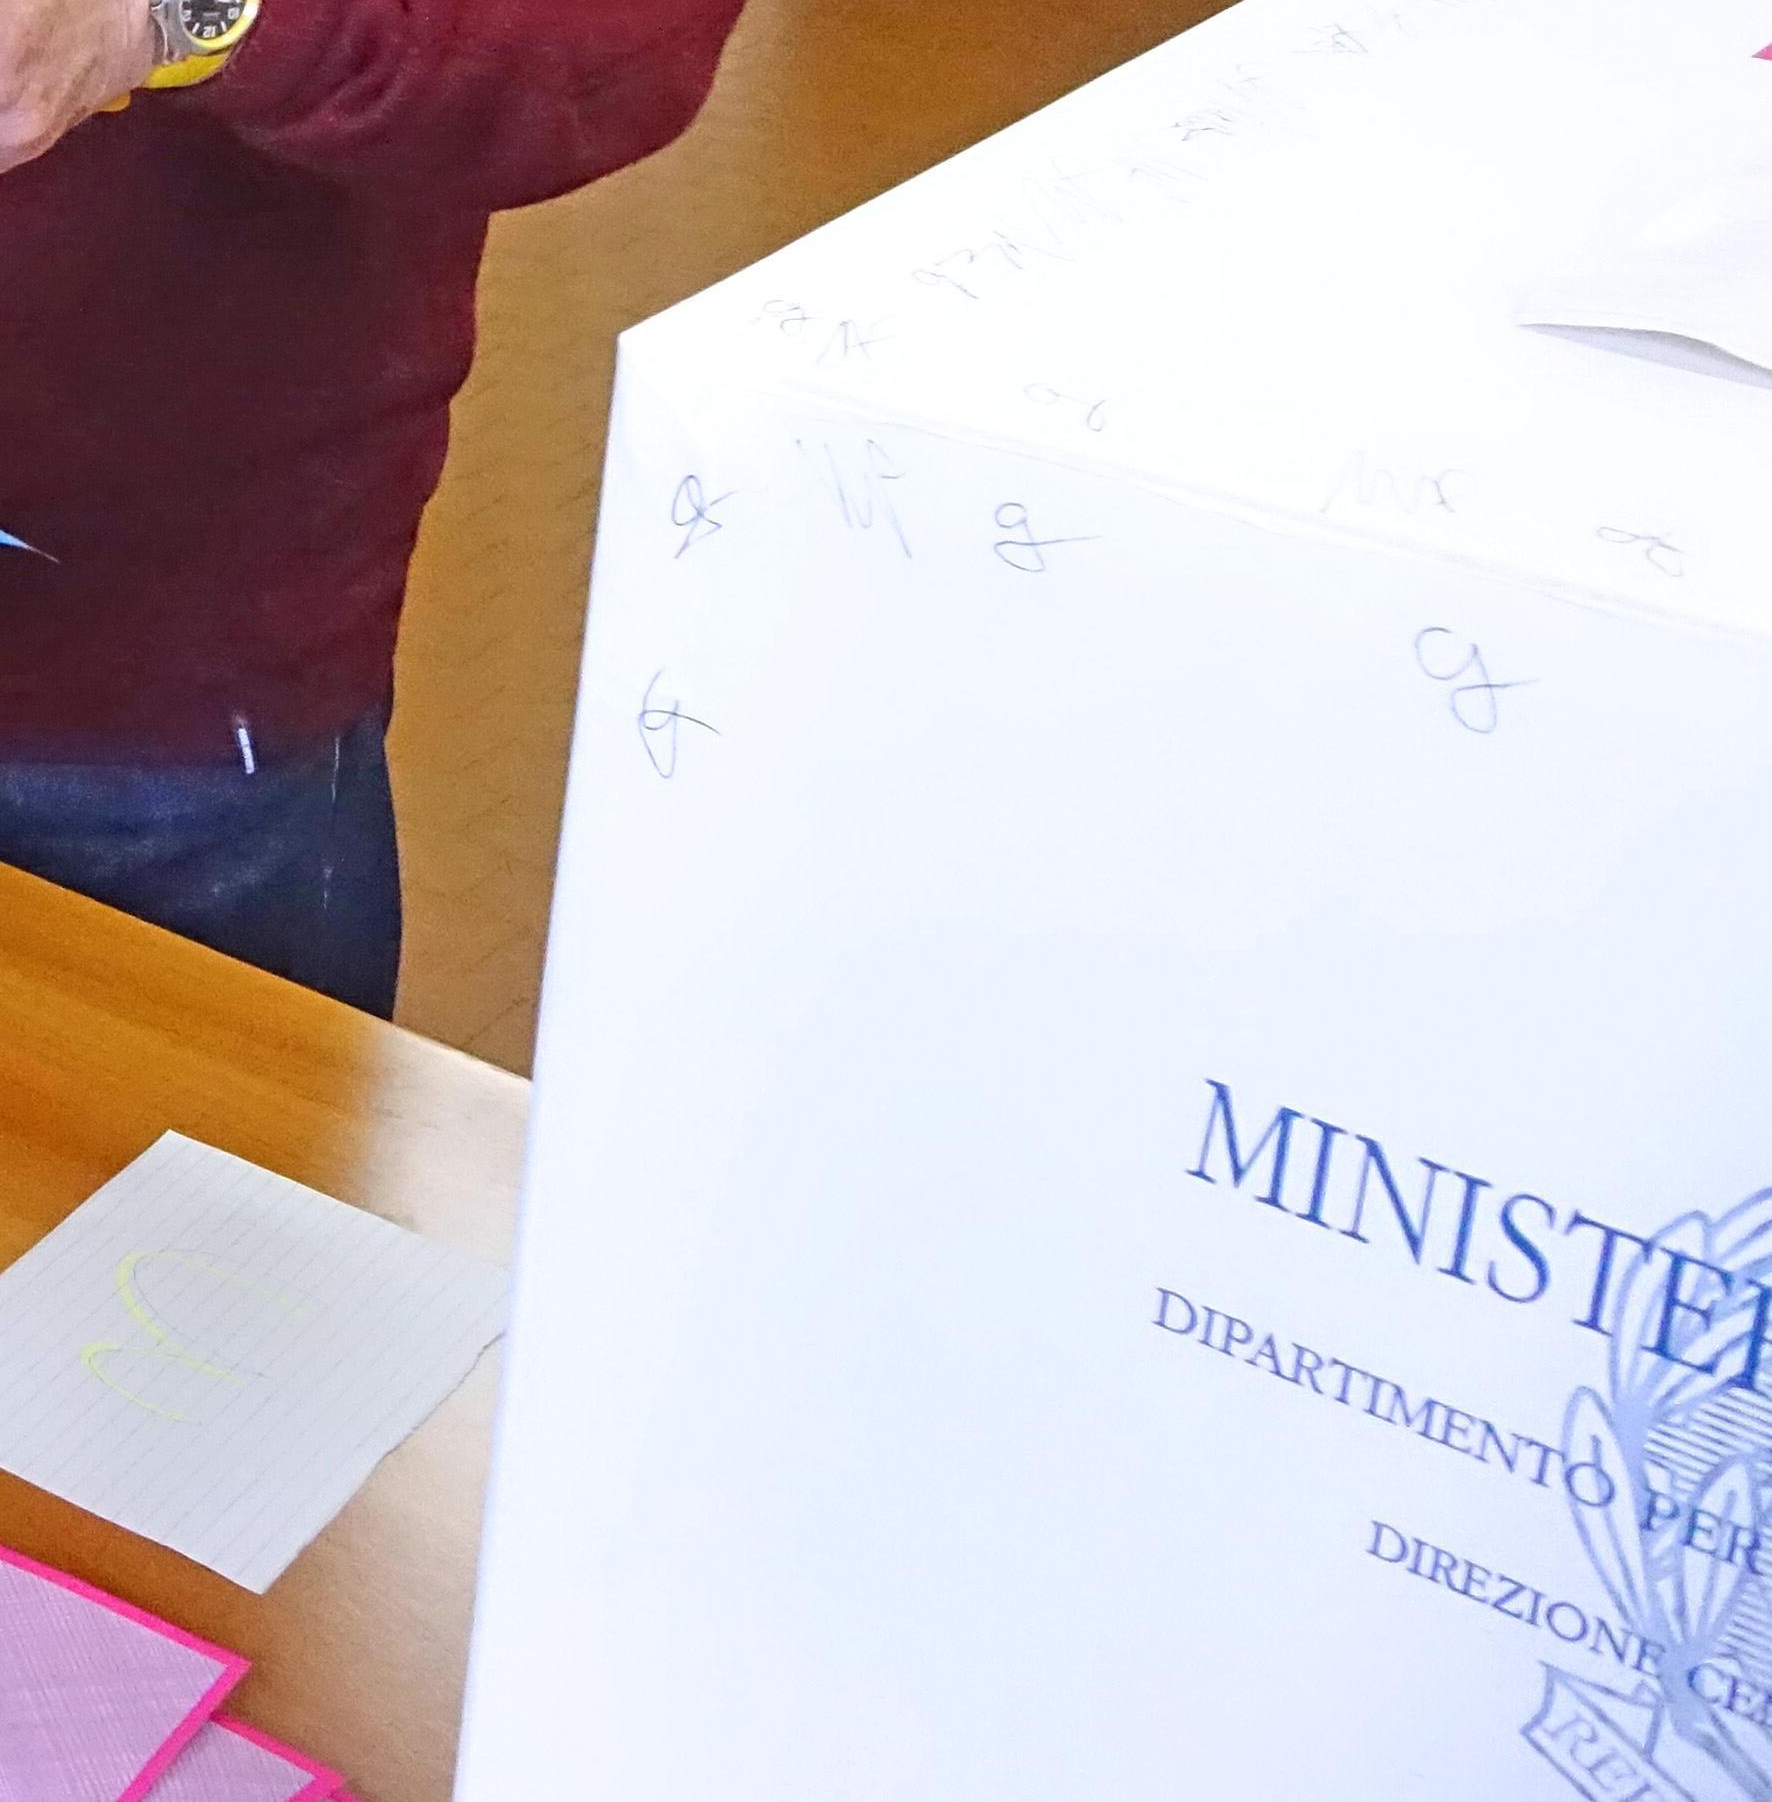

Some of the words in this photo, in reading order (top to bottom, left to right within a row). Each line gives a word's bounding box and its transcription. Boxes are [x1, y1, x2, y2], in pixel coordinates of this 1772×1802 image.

[1151, 1286, 1616, 1510] DIPARTIMENTO
[1639, 1491, 1767, 1577] PER
[1364, 1519, 1667, 1679] DIREZIONE
